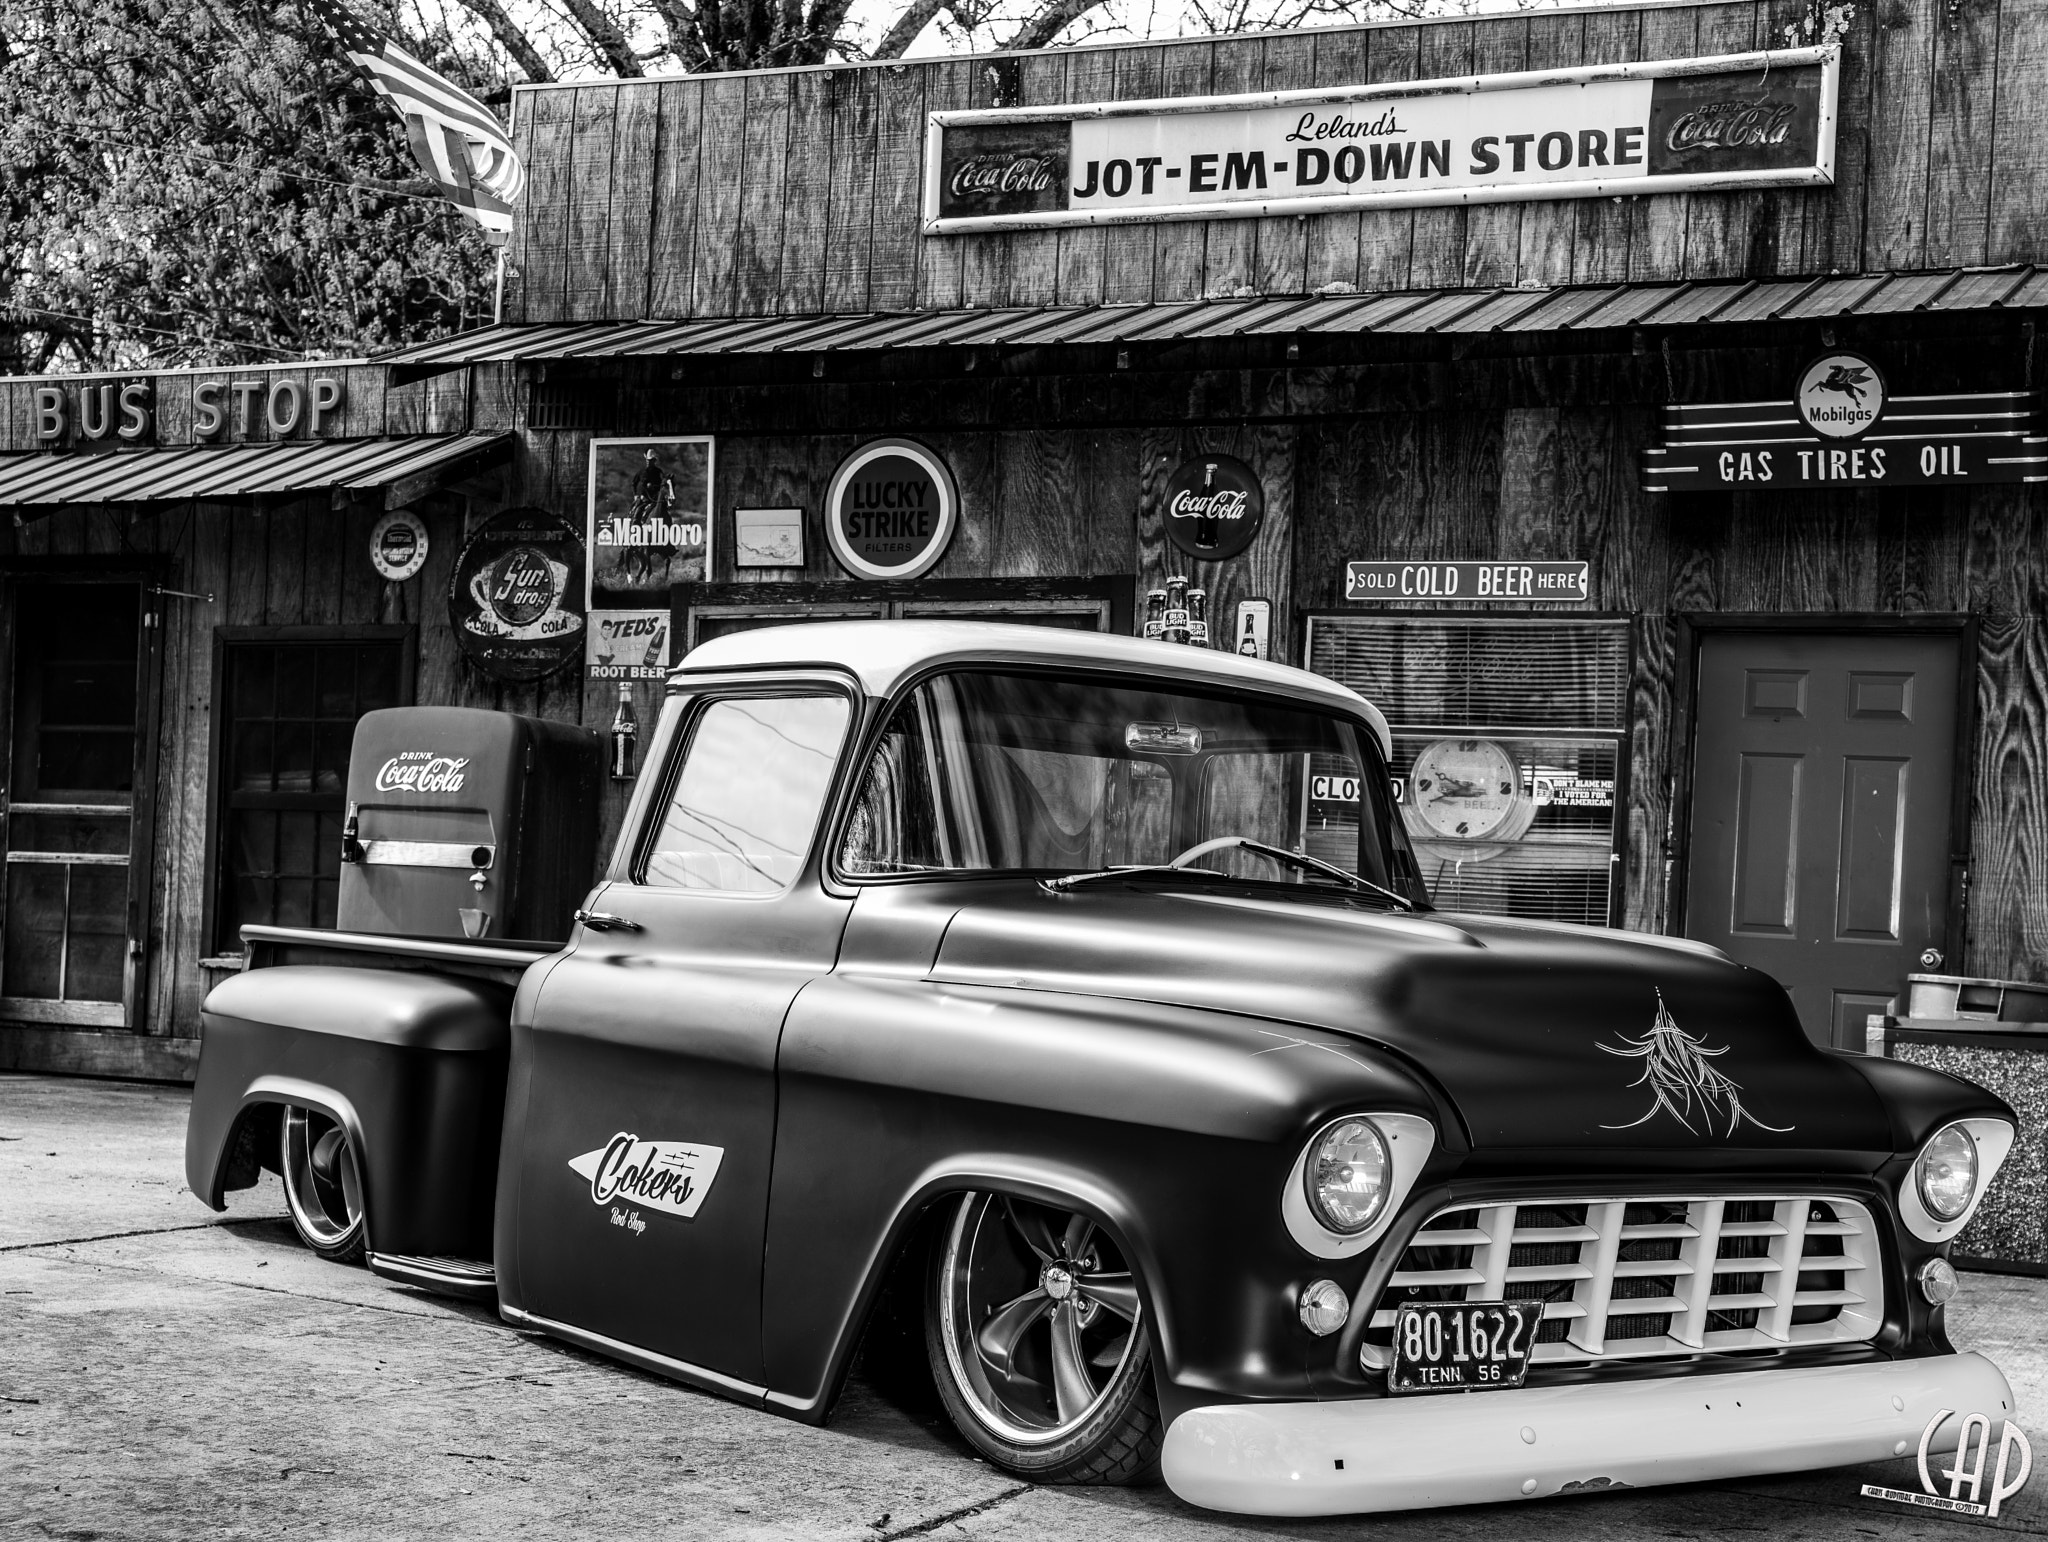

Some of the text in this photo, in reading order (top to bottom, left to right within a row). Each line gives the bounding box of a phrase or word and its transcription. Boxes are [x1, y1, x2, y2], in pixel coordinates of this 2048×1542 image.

[1698, 101, 1748, 115] DRINK
[1285, 107, 1408, 142] Leland's
[1667, 103, 1798, 151] Coca-Cola
[978, 153, 1016, 163] DRINK
[1073, 126, 1645, 198] JOT-EM-DOWN STORE
[951, 156, 1056, 196] Coca-Cola
[36, 378, 343, 441] BUS STOP
[1809, 406, 1873, 426] Mobilgas
[1718, 445, 1969, 482] GAS TIRES OIL
[853, 481, 929, 509] LUCKY
[1170, 489, 1248, 520] Coca-Cola
[613, 517, 703, 546] Marlboro
[848, 511, 929, 538] STRIKE
[865, 543, 912, 553] FILTERS
[1357, 566, 1577, 596] SOLD COLD BEER HERE
[513, 589, 549, 608] drop
[474, 620, 499, 635] COLA
[541, 615, 568, 634] COLA
[612, 616, 660, 639] TED'S
[590, 665, 666, 679] ROOT BEER
[399, 751, 434, 761] DRINK
[375, 757, 471, 792] Coca-Cola
[1419, 778, 1433, 792] 9
[1553, 779, 1614, 788] DON'T BLAME ME!
[1313, 777, 1403, 800] CLOD
[1456, 821, 1469, 834] 6
[594, 1136, 694, 1205] Cokers
[610, 1206, 647, 1237] Rod Shop
[1419, 1365, 1501, 1384] TENN 56
